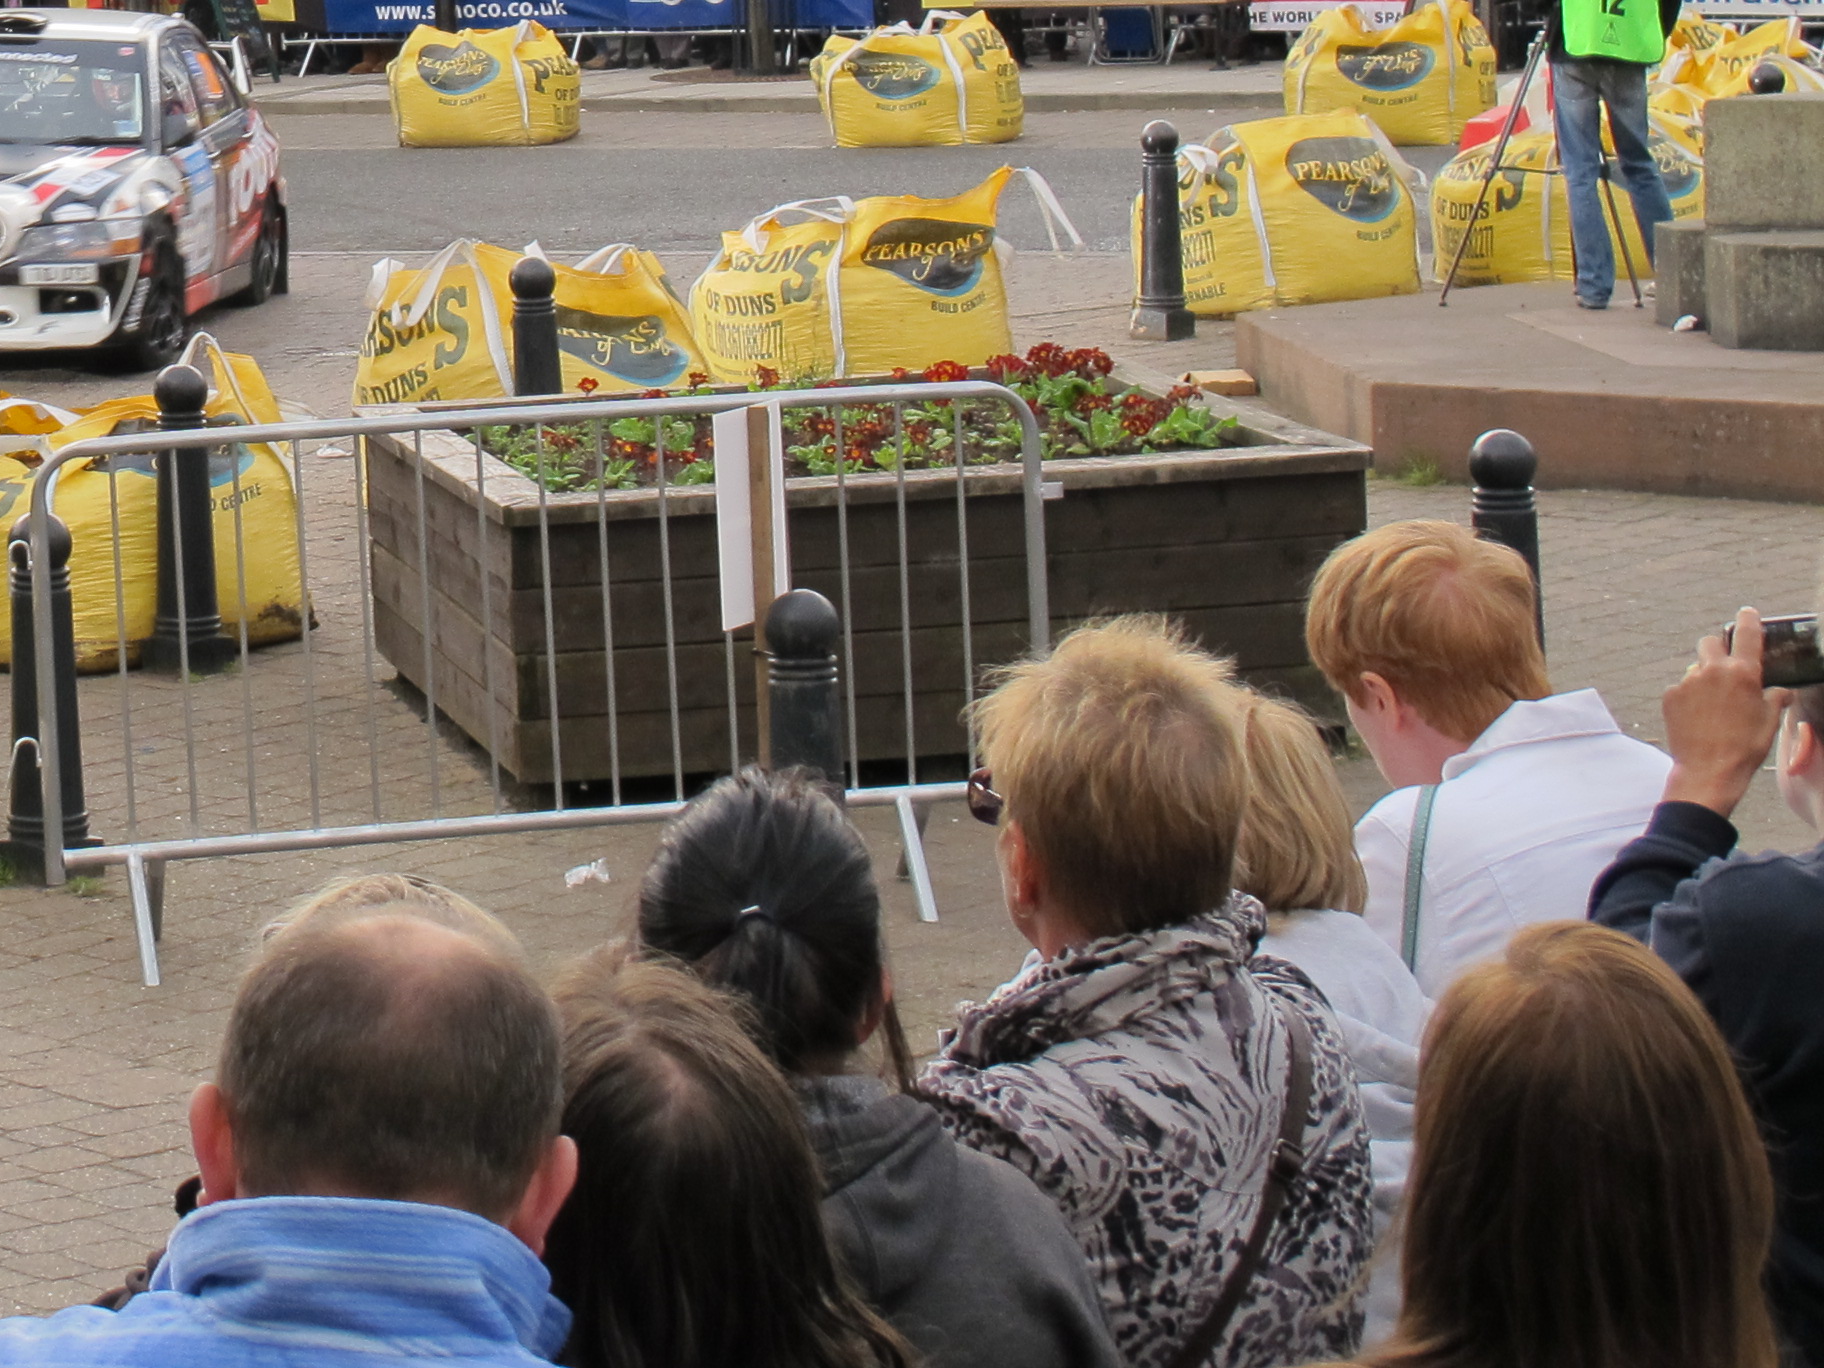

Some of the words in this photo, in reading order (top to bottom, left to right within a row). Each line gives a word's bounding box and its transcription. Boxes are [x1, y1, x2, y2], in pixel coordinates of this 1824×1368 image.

[1273, 11, 1316, 24] WORL
[864, 230, 986, 263] PEARSONS
[706, 287, 721, 314] OF
[726, 293, 777, 317] DUNS
[931, 299, 958, 315] BUILD
[372, 362, 429, 405] DUNS
